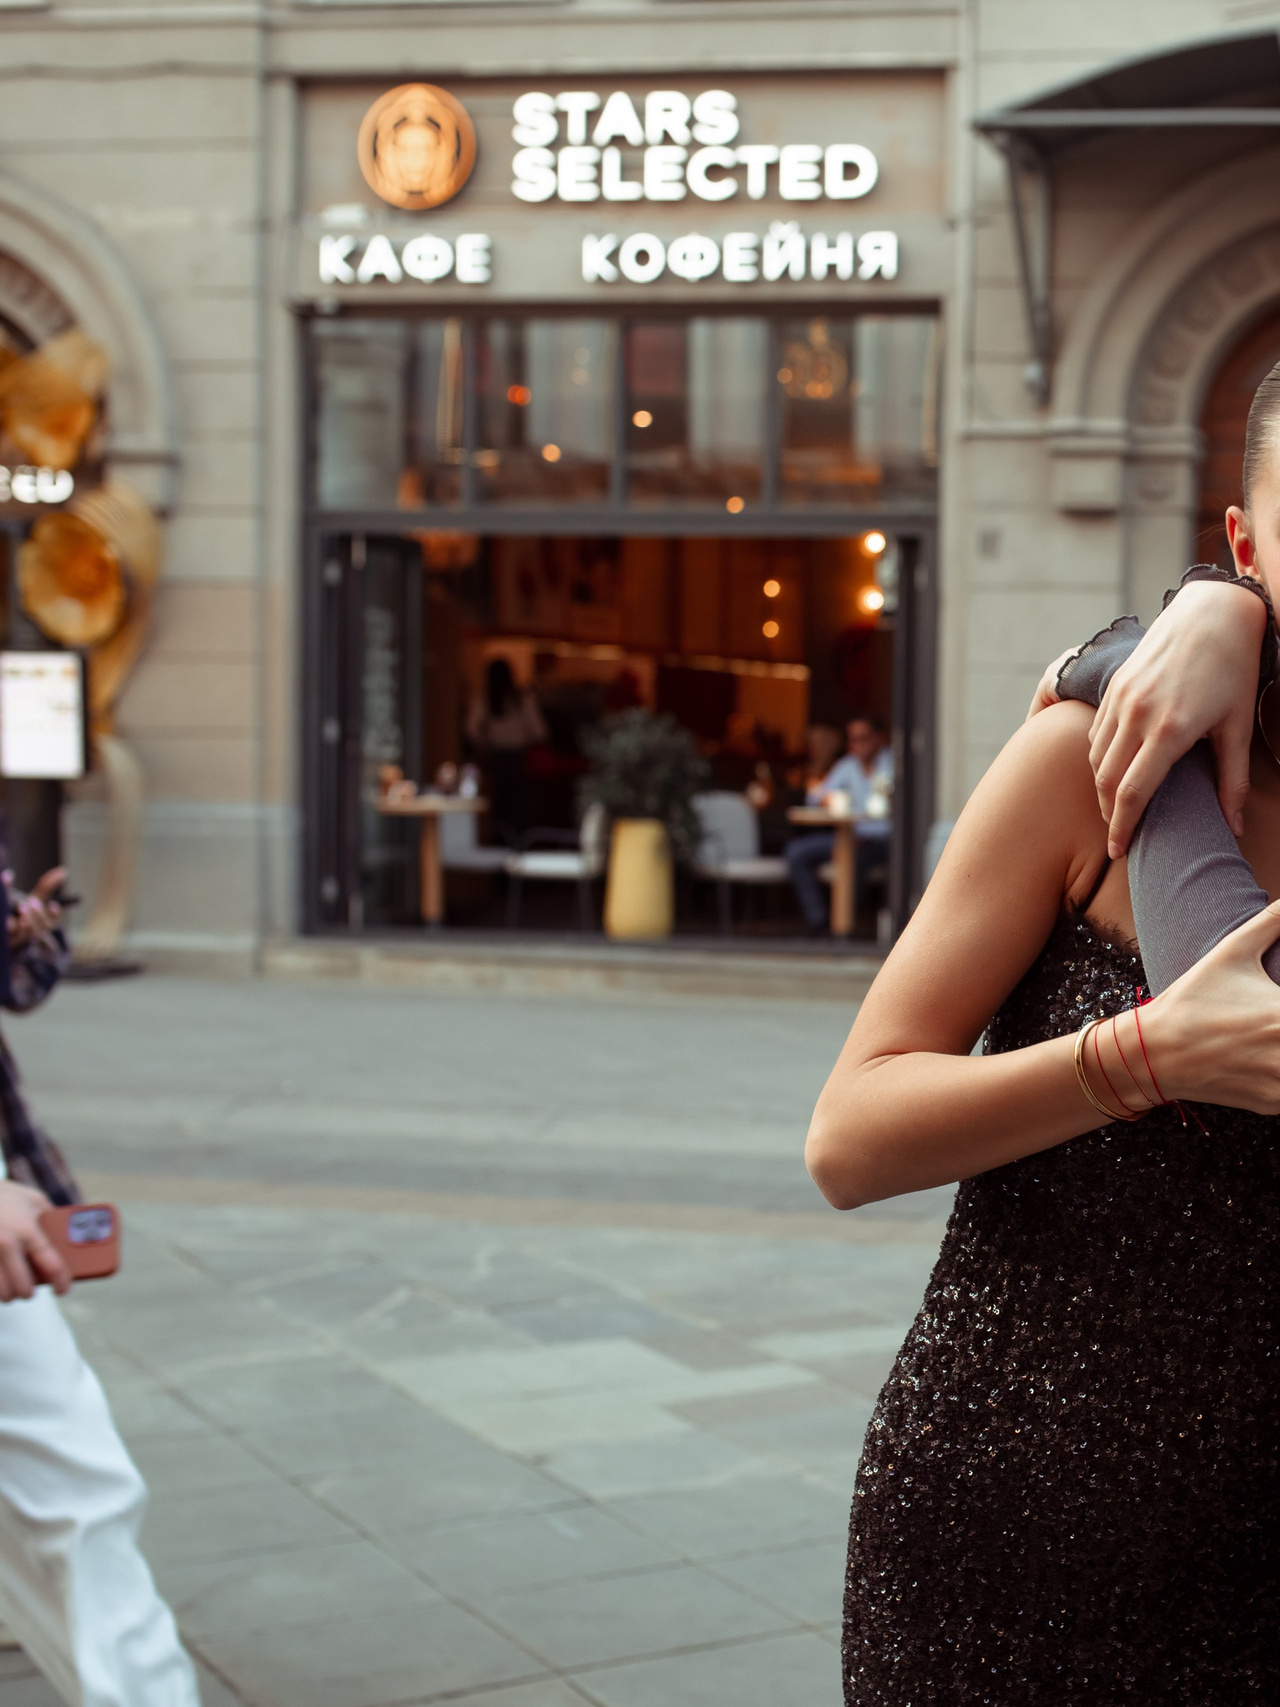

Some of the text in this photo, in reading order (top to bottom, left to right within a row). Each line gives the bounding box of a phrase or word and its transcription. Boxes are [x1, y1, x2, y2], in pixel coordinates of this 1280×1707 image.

[511, 90, 738, 147] STARS
[511, 144, 878, 202] SELECTED
[318, 233, 492, 283] КАФЕ
[581, 221, 898, 282] КОФЕЙНЯ
